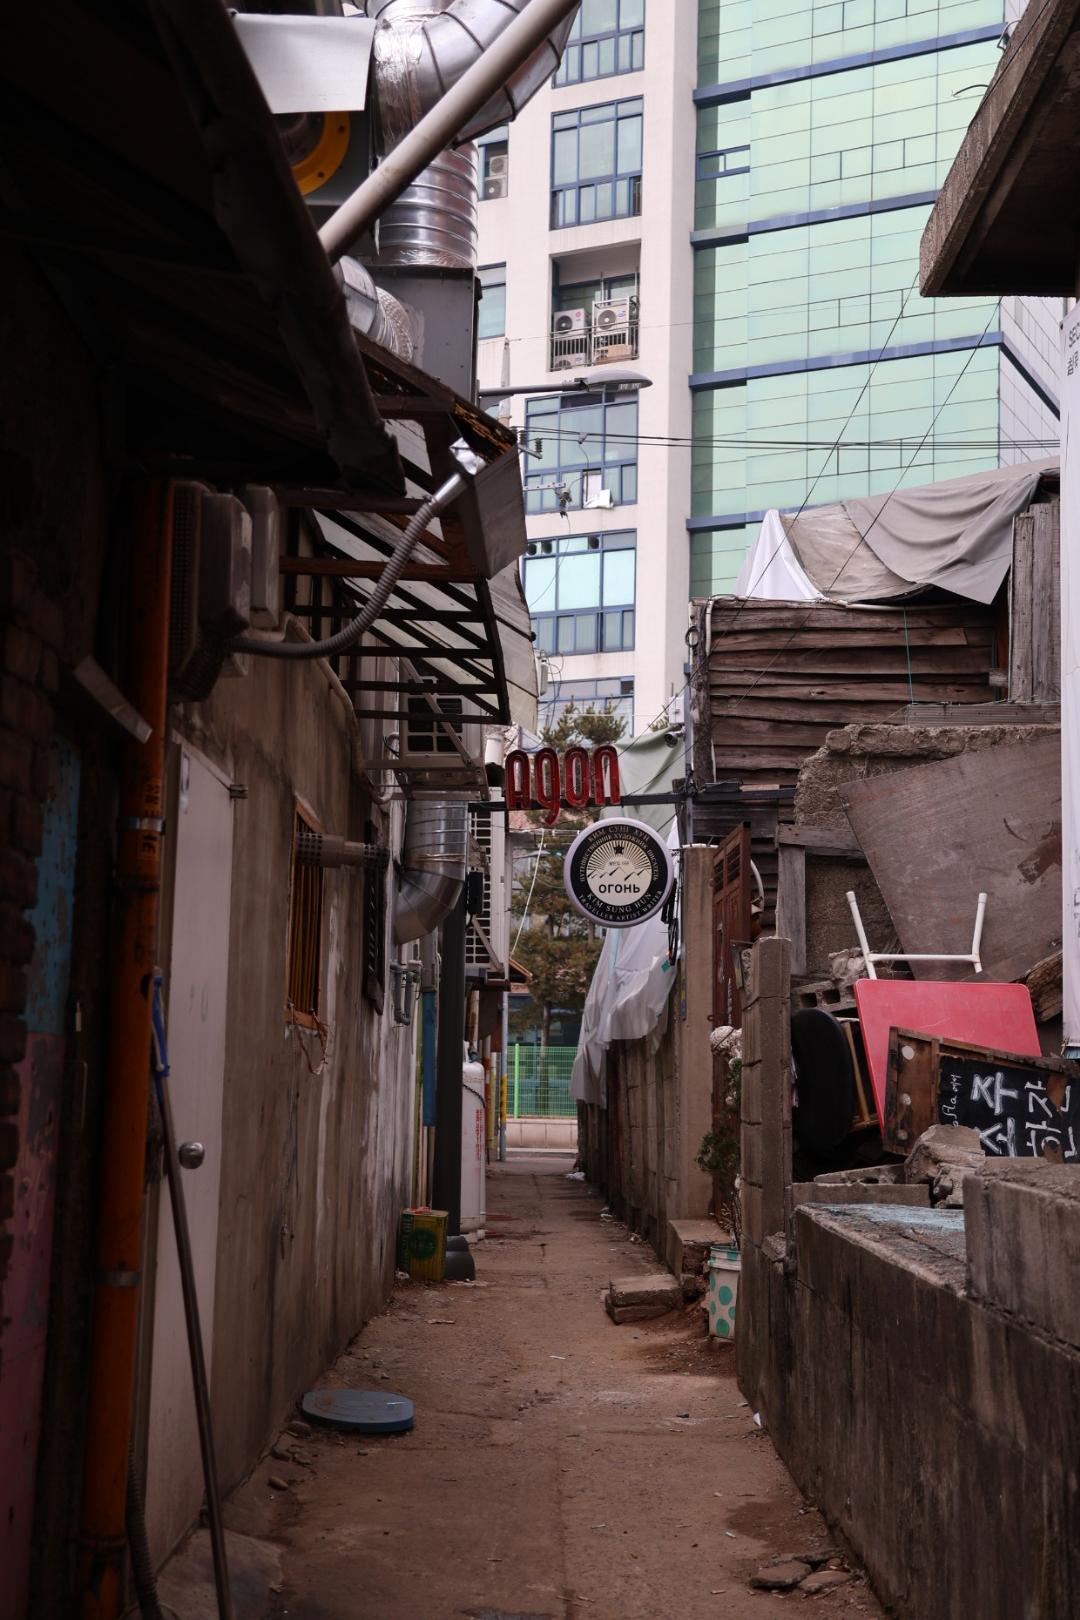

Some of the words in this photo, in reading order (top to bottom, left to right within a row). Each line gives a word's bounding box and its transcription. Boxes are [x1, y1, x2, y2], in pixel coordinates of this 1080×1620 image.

[578, 894, 613, 920] TRAVELLER
[616, 911, 641, 921] ARTIST
[643, 890, 663, 913] WRITER
[587, 893, 603, 908] KIM
[606, 904, 632, 913] SUNG
[635, 893, 652, 908] HUN
[970, 1071, 1019, 1158] 소주
